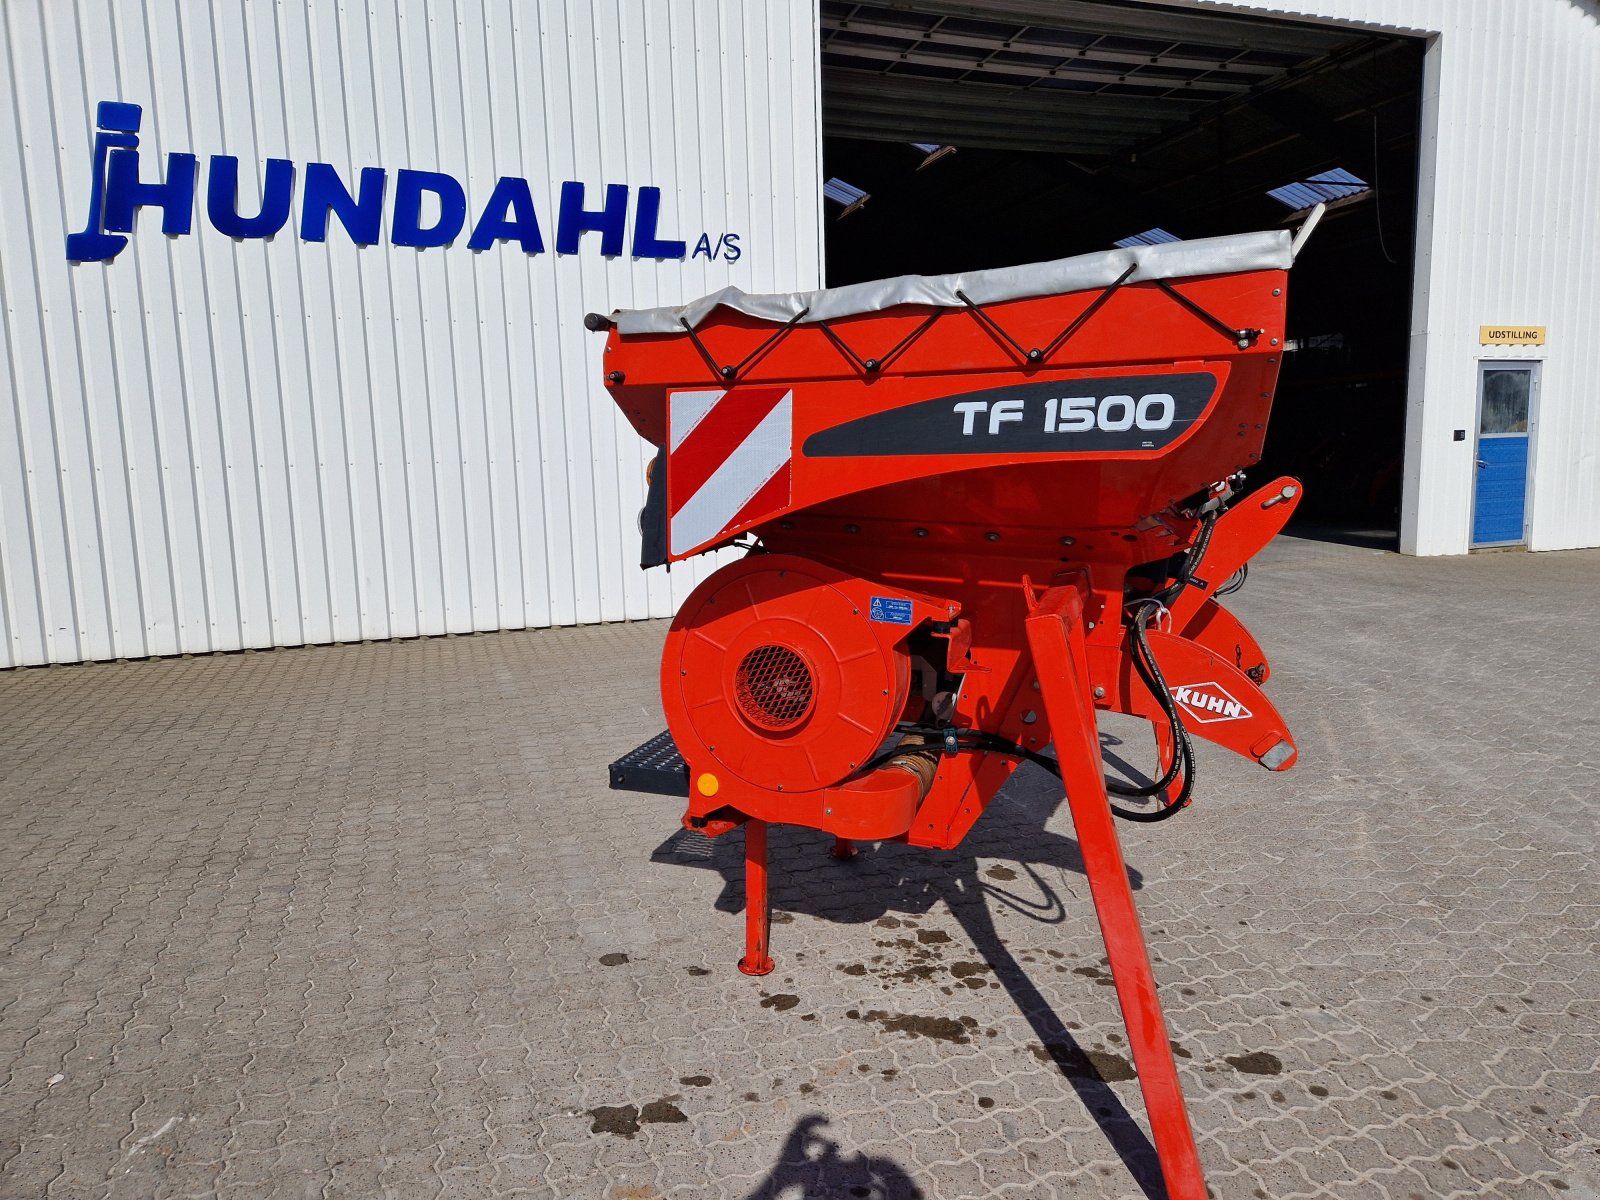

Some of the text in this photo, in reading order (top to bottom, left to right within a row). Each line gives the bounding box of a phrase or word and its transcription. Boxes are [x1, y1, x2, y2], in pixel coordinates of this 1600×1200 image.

[692, 232, 741, 260] A/S
[1488, 330, 1538, 339] UDSTILLING
[953, 393, 1176, 436] TF 1500
[1175, 686, 1242, 718] KUHN
